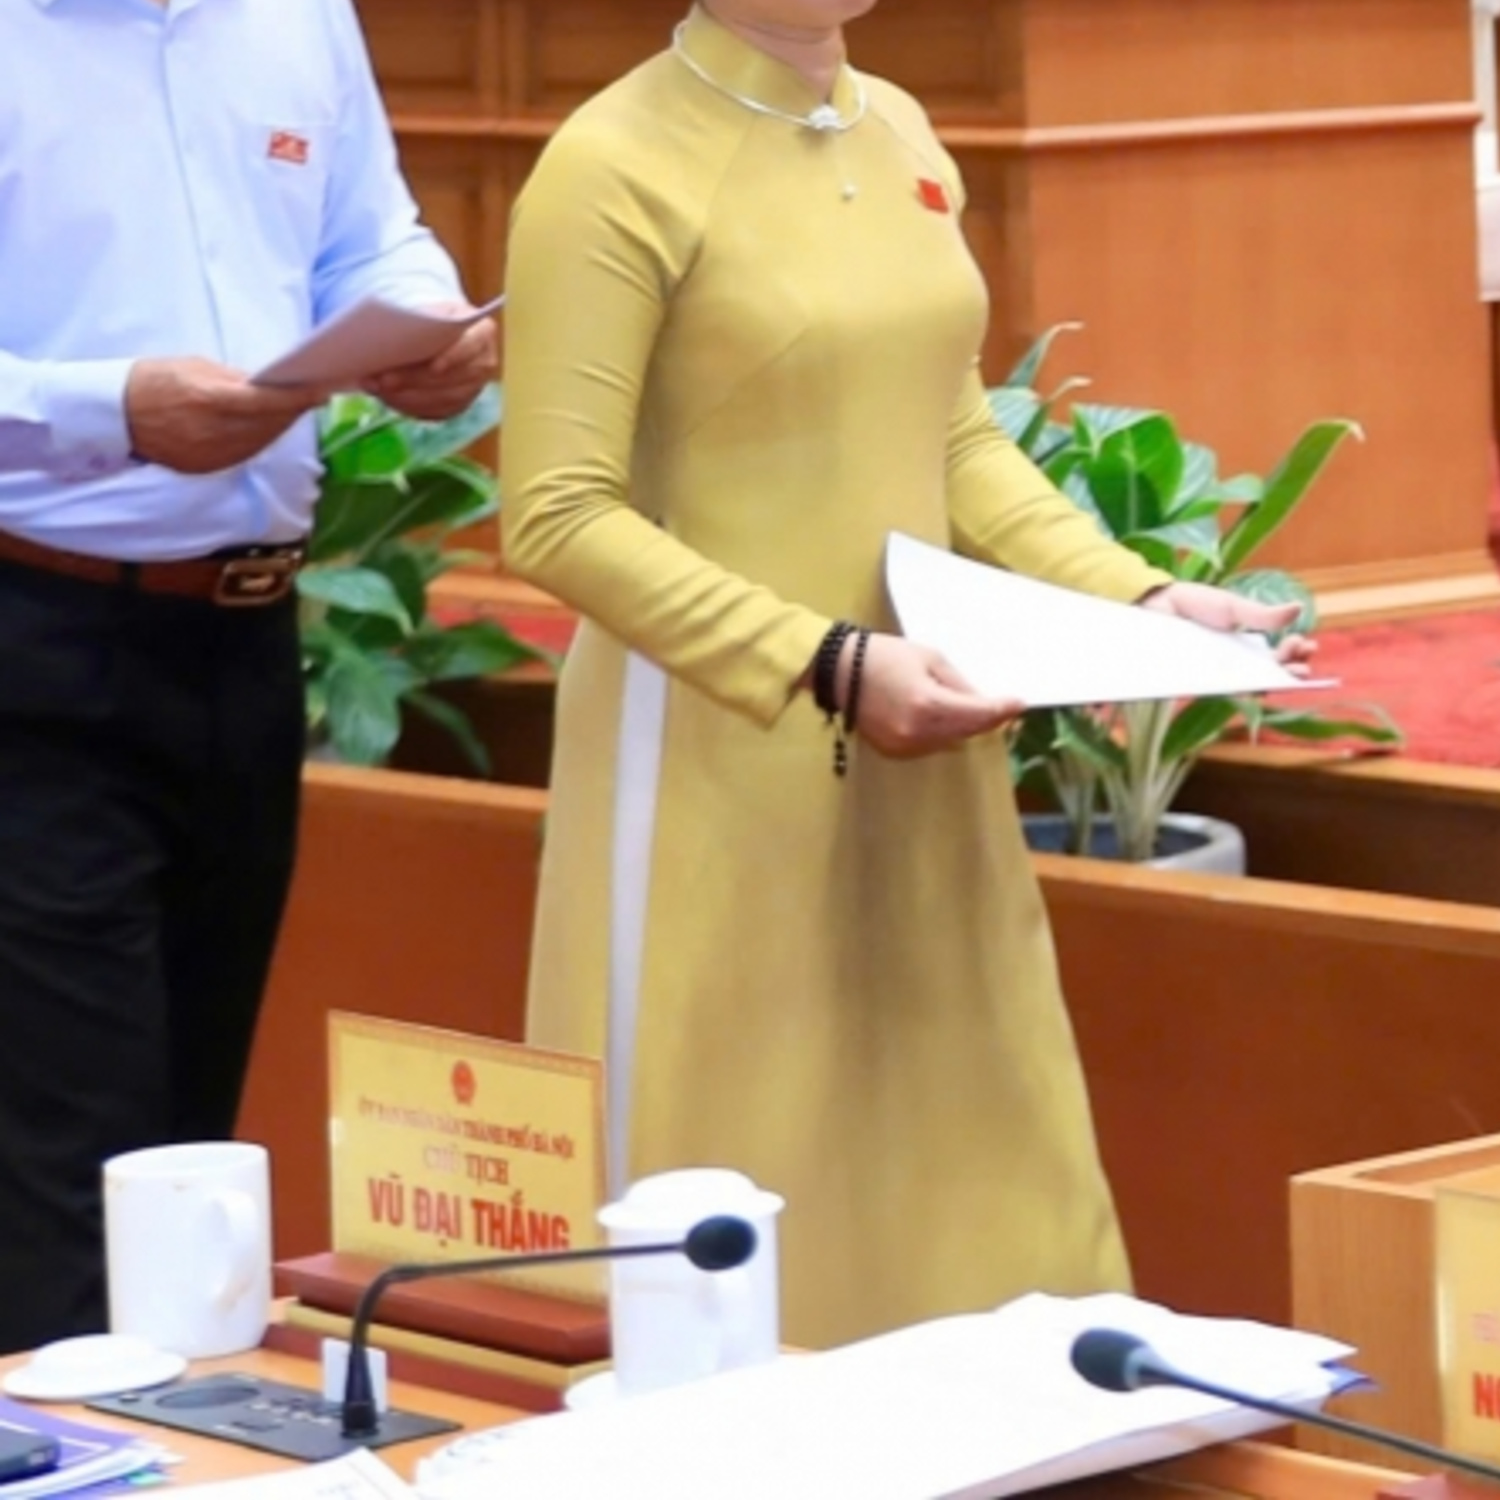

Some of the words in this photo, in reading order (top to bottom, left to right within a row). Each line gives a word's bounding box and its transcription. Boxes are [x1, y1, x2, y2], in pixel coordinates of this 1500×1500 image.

[463, 1151, 509, 1186] TỊCH
[368, 1172, 404, 1227] VŨ
[413, 1185, 462, 1247] ĐẠI
[471, 1188, 571, 1252] THẮNG
